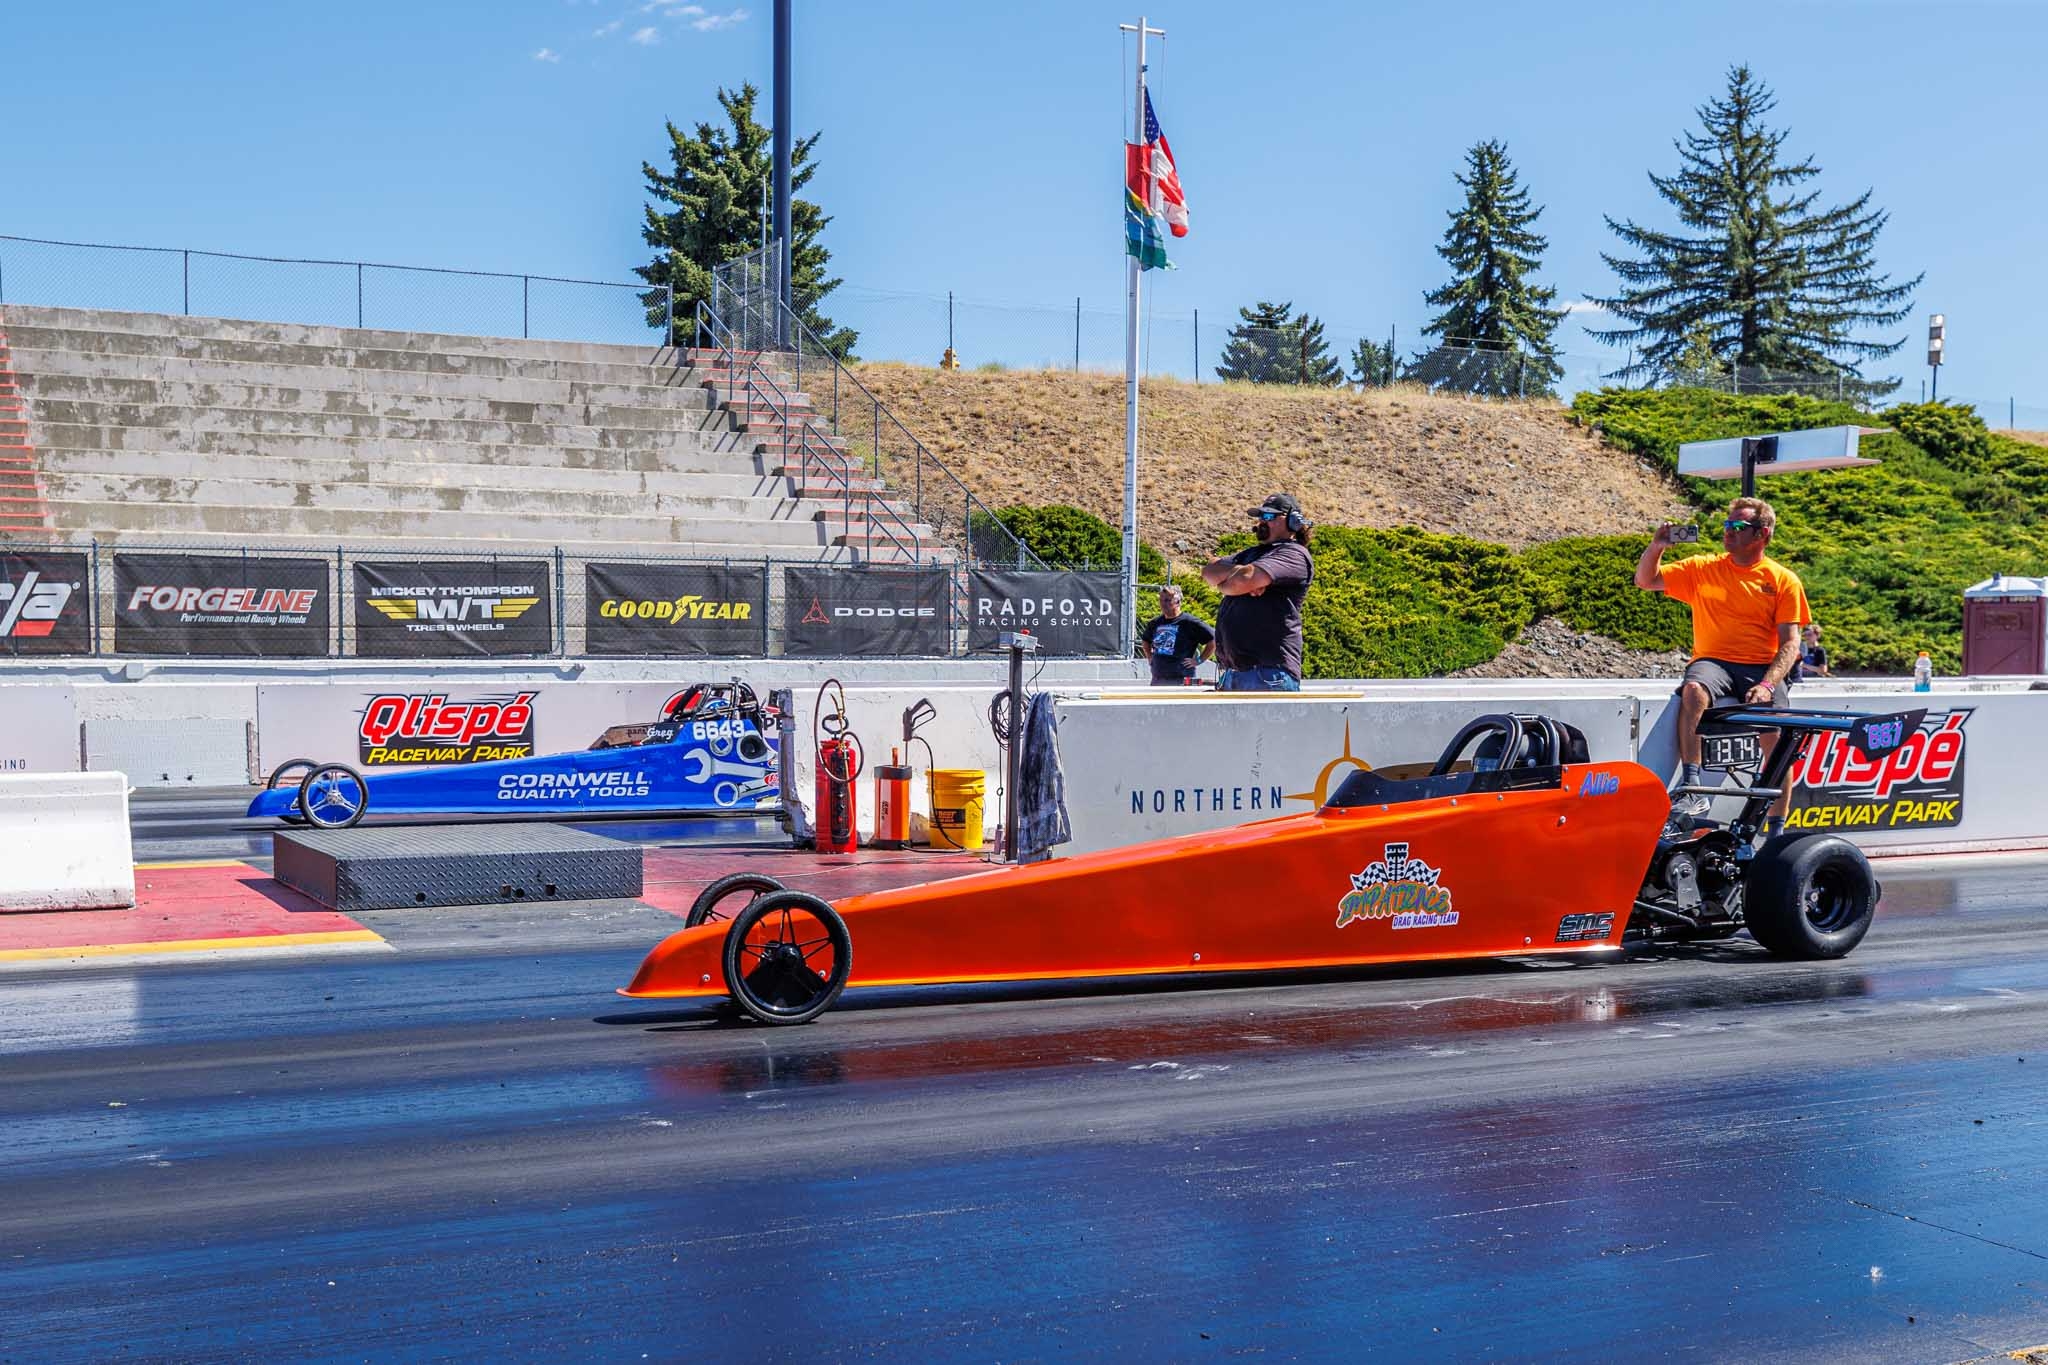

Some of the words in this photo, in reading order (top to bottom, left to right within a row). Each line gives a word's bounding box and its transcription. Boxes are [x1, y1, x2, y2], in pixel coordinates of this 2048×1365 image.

[128, 586, 317, 613] FORGELINE
[371, 587, 437, 596] MICKEY
[439, 586, 534, 596] THOMPSON
[416, 597, 502, 621] M/T
[835, 607, 935, 617] DODGE
[979, 597, 1112, 616] RADFORD
[180, 612, 233, 624] Performance
[234, 614, 250, 624] and
[250, 613, 278, 625] Racing
[279, 614, 307, 624] Wheels
[456, 623, 504, 631] WHEELS
[978, 617, 1041, 627] RACING
[1050, 617, 1113, 626] SCHOOL
[361, 692, 534, 746] Qlispé
[646, 727, 674, 740] Greg
[692, 720, 745, 741] 6643
[367, 747, 472, 764] RACEWAY
[471, 745, 531, 762] PARK
[1716, 737, 1755, 763] 13.74
[499, 772, 652, 789] CORNWELL
[1579, 770, 1619, 798] Allie
[497, 787, 580, 801] QUALITY
[588, 785, 649, 798] TOOLS
[1131, 786, 1282, 814] NORTHERN
[1889, 800, 1960, 826] PARK
[1393, 915, 1412, 928] DRAG
[1412, 913, 1438, 926] RACING
[1437, 912, 1458, 924] TEAM
